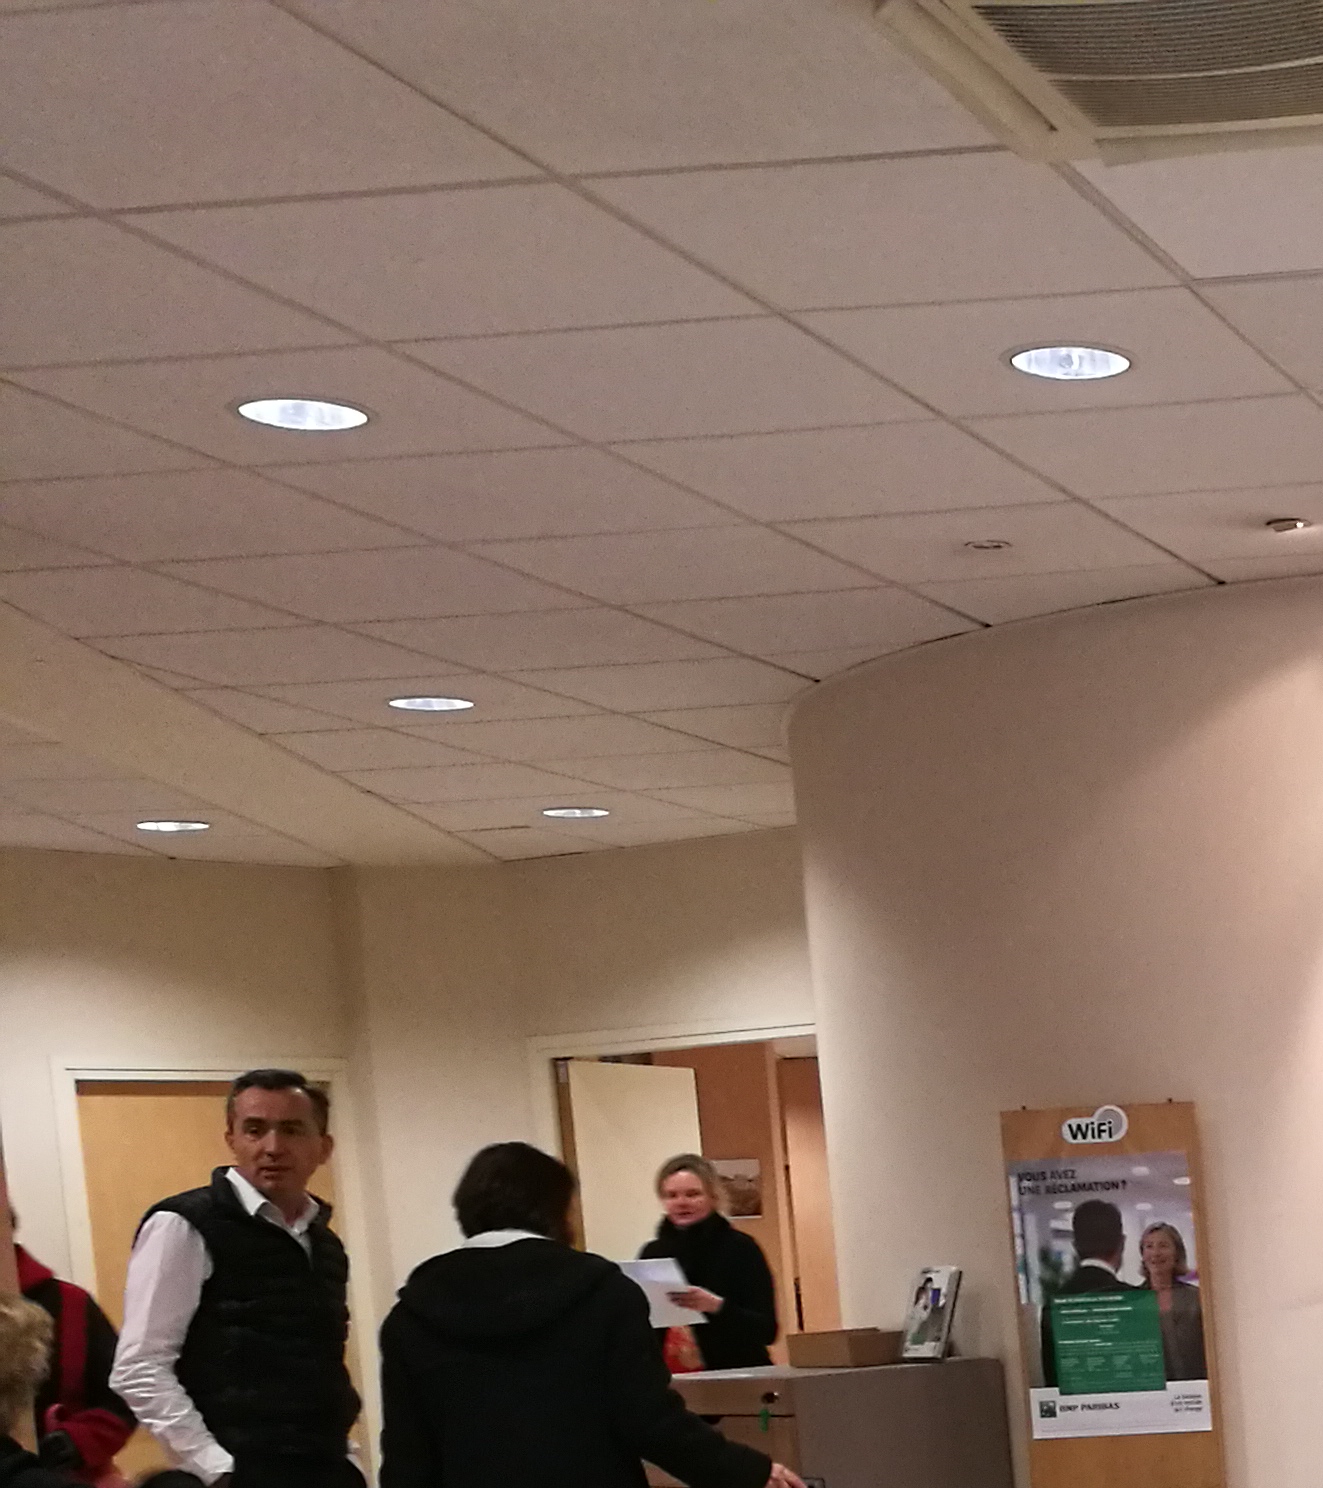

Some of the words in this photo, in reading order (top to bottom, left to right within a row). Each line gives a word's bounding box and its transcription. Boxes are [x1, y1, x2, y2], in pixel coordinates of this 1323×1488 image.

[1067, 1120, 1113, 1141] WiFi
[1018, 1171, 1047, 1182] VOUS
[1049, 1169, 1077, 1180] AVEZ
[1018, 1185, 1042, 1196] UNE
